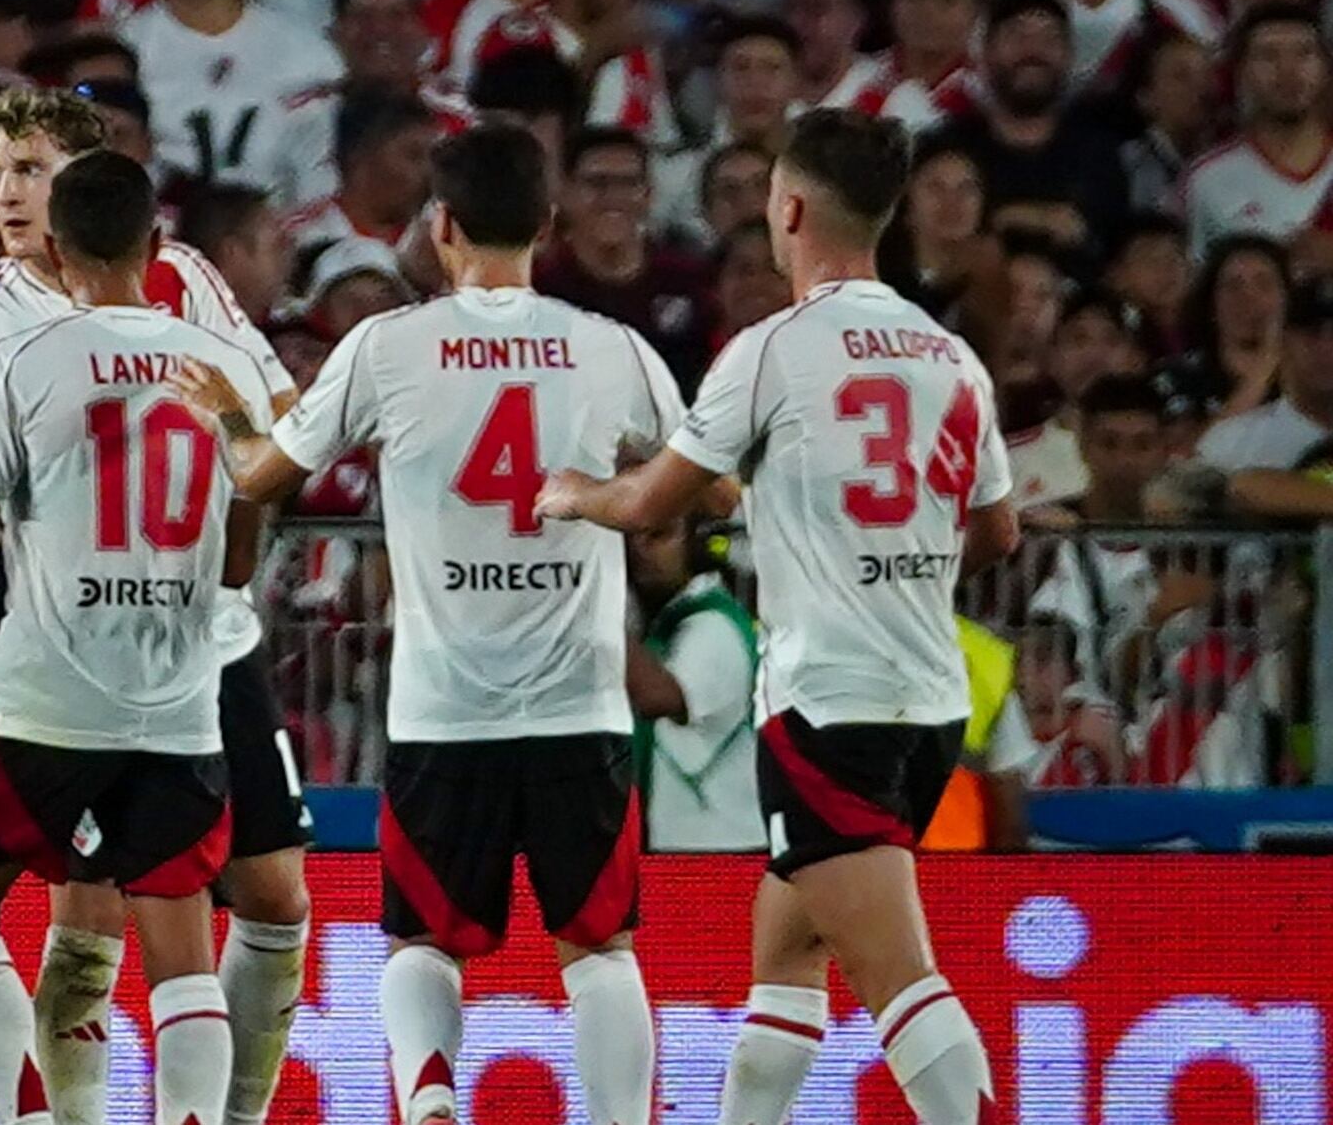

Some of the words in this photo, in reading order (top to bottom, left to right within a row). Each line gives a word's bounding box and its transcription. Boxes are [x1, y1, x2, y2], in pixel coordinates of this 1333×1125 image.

[440, 337, 577, 370] MONTIEL
[86, 397, 217, 552] 10
[449, 381, 546, 537] 4
[834, 374, 982, 530] 34
[76, 577, 196, 608] DIRECTV
[443, 560, 582, 591] DIRECTV
